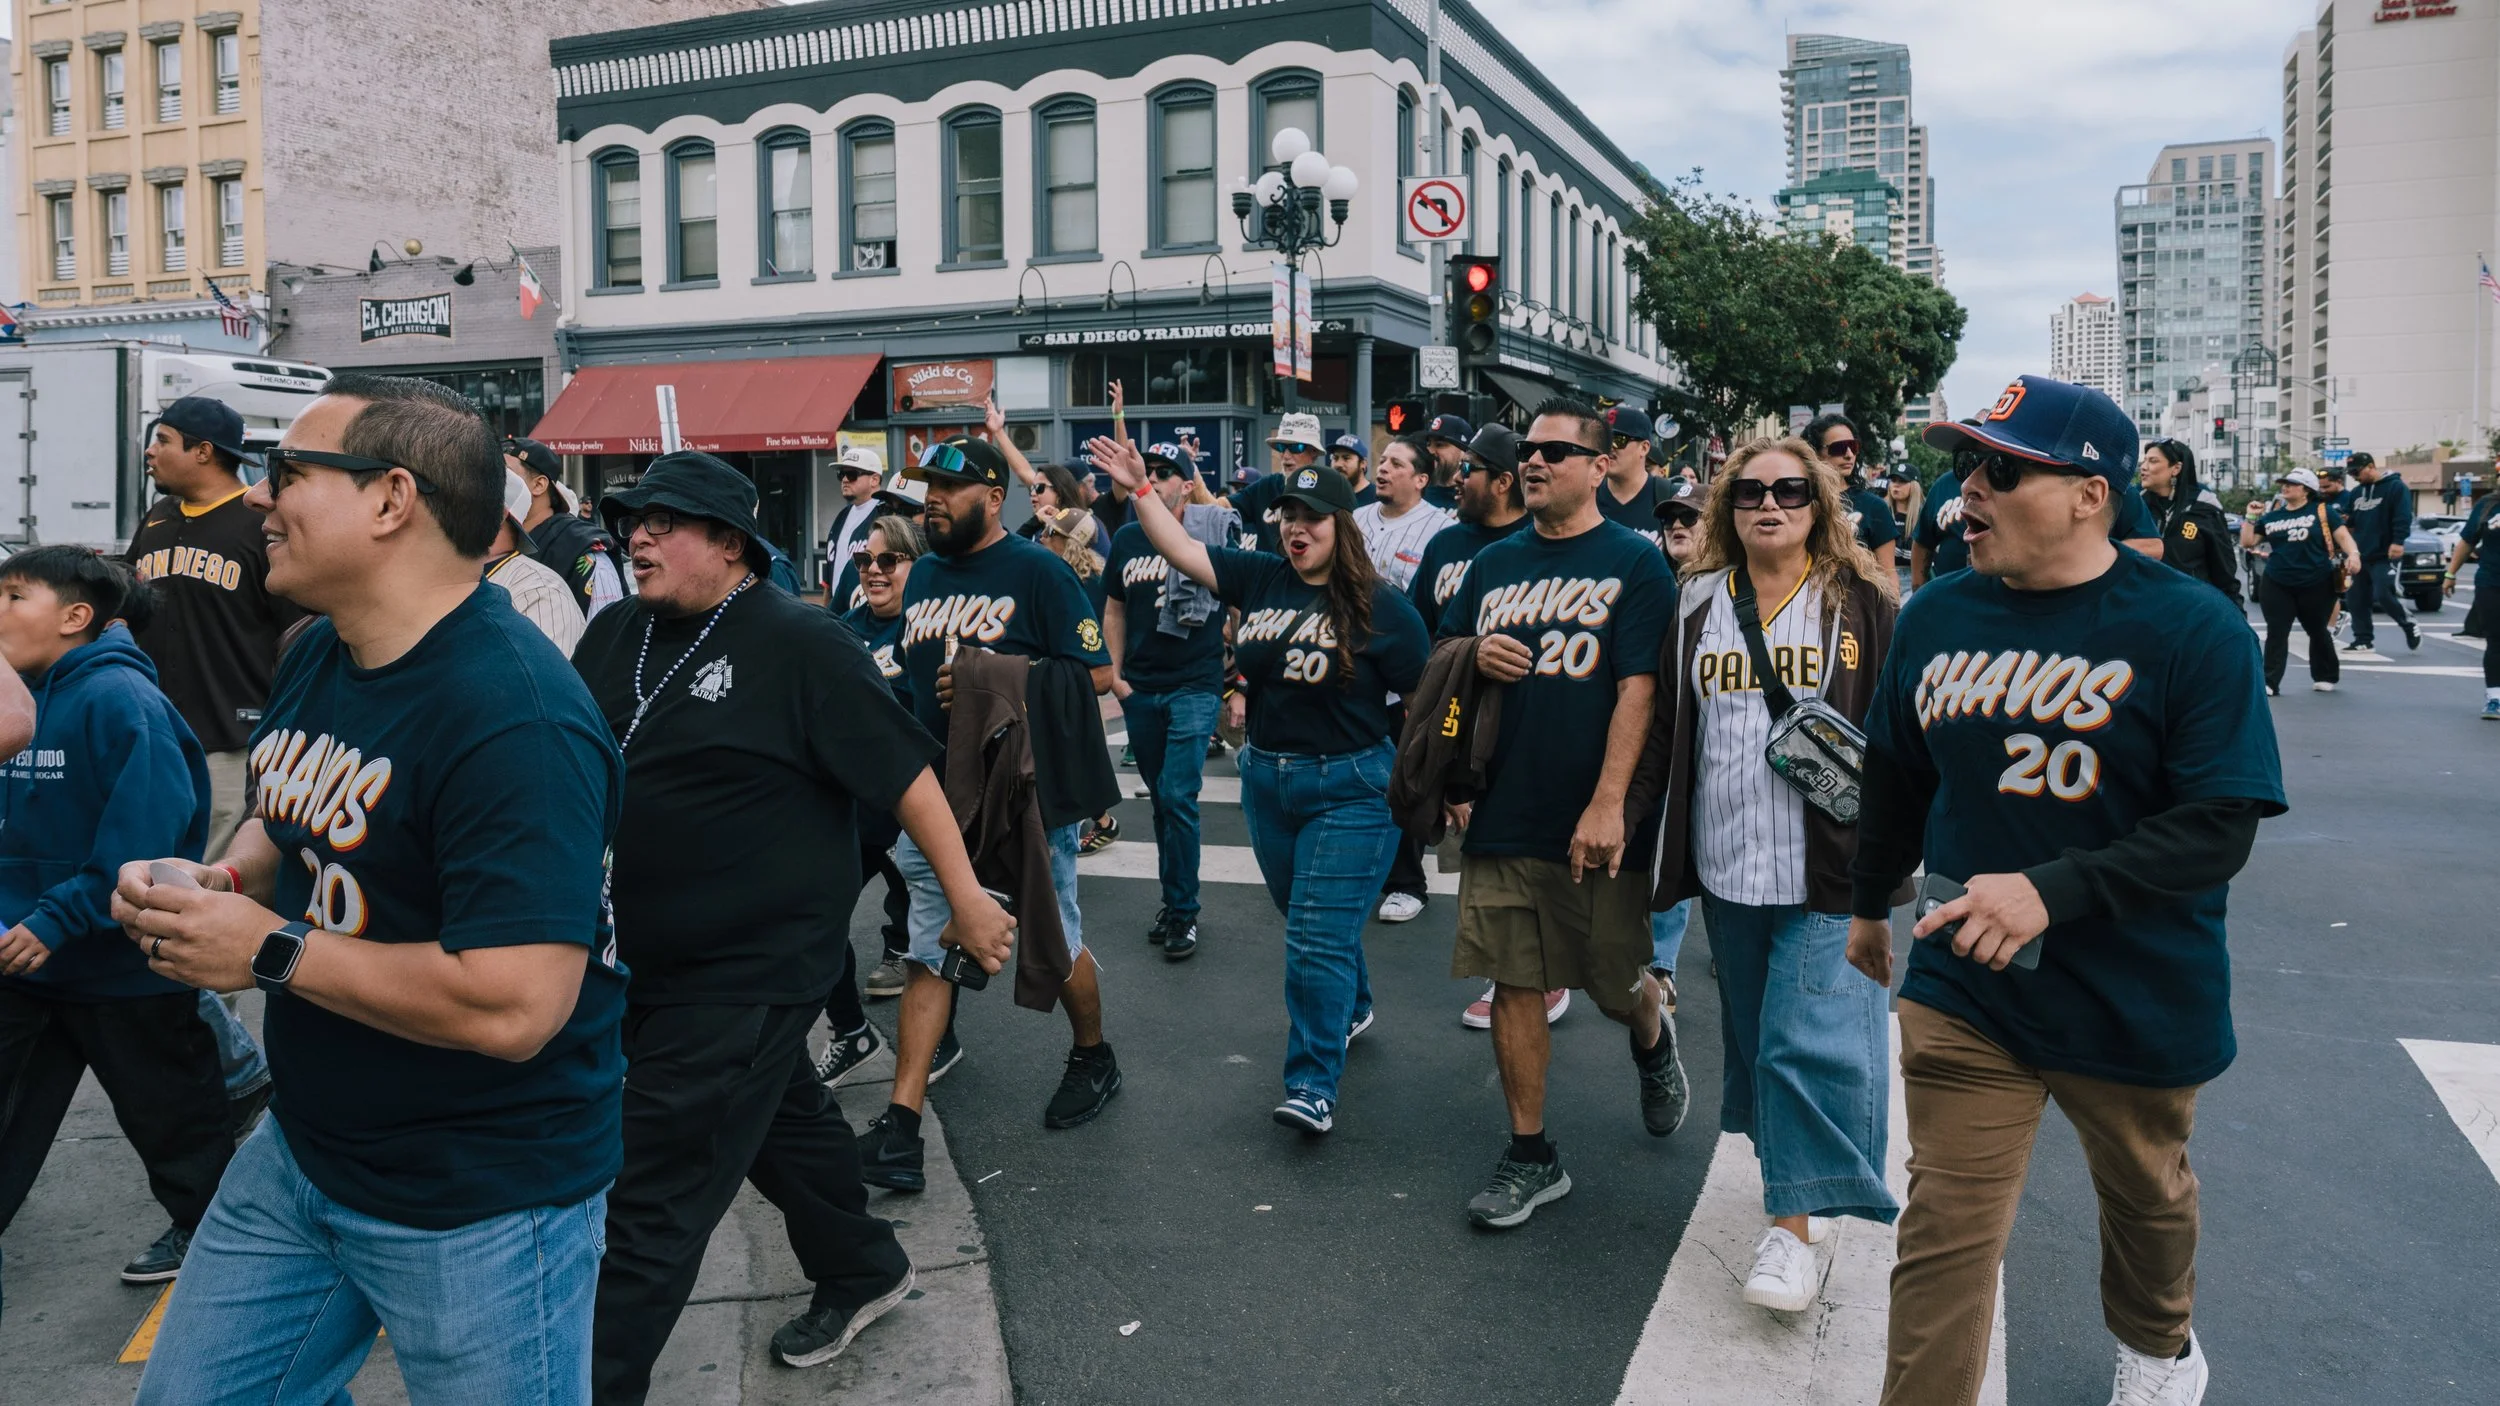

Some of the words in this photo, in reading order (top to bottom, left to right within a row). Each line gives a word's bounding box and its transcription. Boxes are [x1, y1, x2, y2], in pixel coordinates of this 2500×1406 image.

[361, 300, 380, 331] EL
[382, 295, 450, 327] CHINGON
[374, 328, 389, 337] BAD
[391, 326, 403, 334] ASS
[405, 324, 437, 334] MEXICAN
[1044, 332, 1080, 345] SAN
[1083, 329, 1141, 343] DIEGO
[1143, 325, 1227, 340] TRADING
[1229, 320, 1324, 336] COMY
[259, 375, 292, 386] THERMO
[293, 379, 311, 387] KING
[907, 366, 941, 389] Nikki
[942, 365, 956, 377] &
[550, 441, 556, 450] &
[558, 441, 581, 451] Antique
[582, 440, 604, 450] Jewelry
[629, 438, 659, 452] Nikki
[766, 436, 780, 447] Fine
[781, 436, 800, 446] Swiss
[801, 435, 829, 446] Watches
[606, 475, 627, 487] Nikki
[2287, 528, 2309, 541] 20
[171, 545, 242, 591] DIEGO
[901, 594, 1016, 655] CHAVOS
[1475, 576, 1623, 637] CHAVOS
[1283, 648, 1329, 685] 20
[1535, 630, 1600, 680] 20
[1914, 650, 2136, 732] CHAVOS
[1997, 732, 2102, 802] 20
[250, 728, 392, 852] CHAVOS
[301, 847, 369, 937] 20
